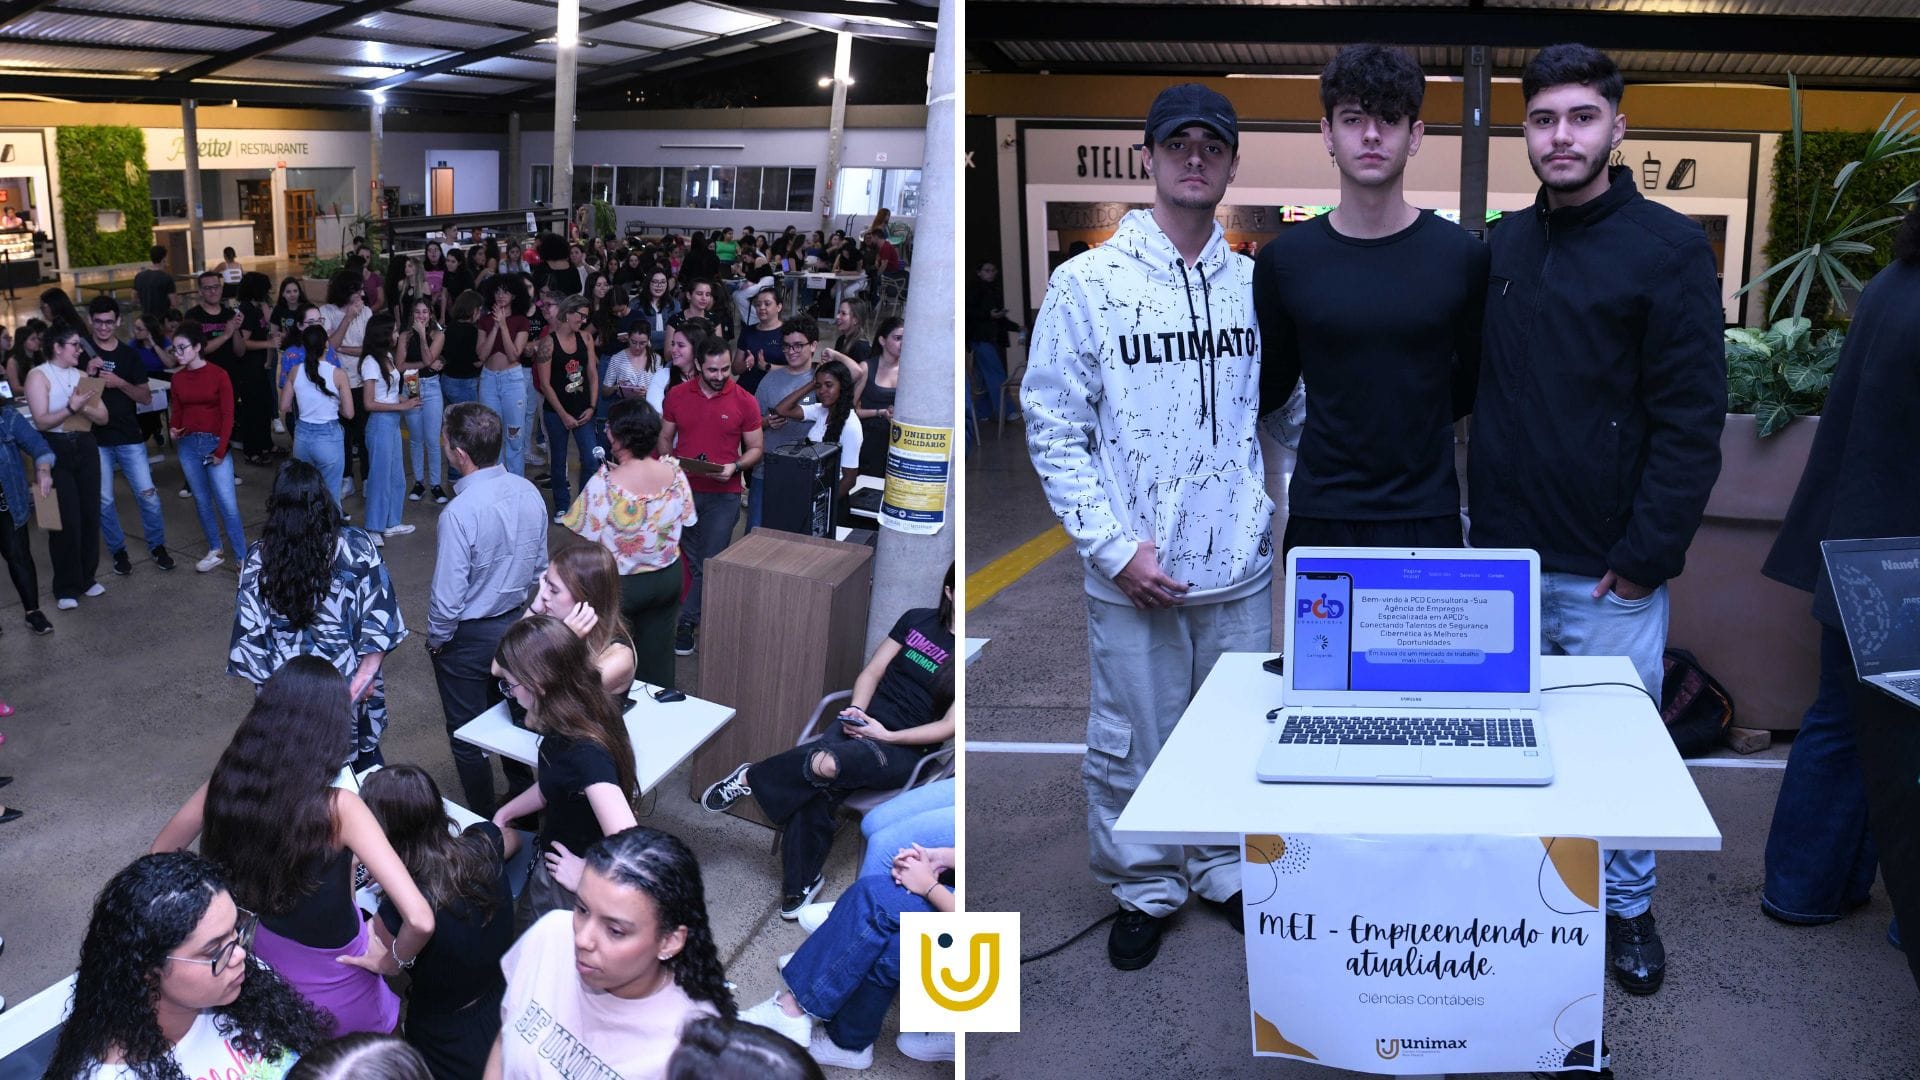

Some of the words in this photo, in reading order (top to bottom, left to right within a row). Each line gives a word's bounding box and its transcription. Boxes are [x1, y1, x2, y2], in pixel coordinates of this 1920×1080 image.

[240, 143, 309, 155] RESTAURANTE
[1119, 327, 1256, 366] ULTIMATO
[904, 430, 946, 440] UNIEDUK
[1426, 596, 1468, 604] Consultoria
[1297, 597, 1345, 619] PCD
[1385, 605, 1414, 613] Agência
[1426, 605, 1464, 613] Empregos
[1378, 613, 1428, 621] Especializada
[1449, 622, 1489, 631] Segurança
[1434, 630, 1468, 638] Melhores
[1397, 638, 1451, 647] Oportunidades
[905, 649, 939, 674] UNIMAX
[1259, 911, 1318, 941] MEI
[1347, 914, 1545, 950] Empreendendo
[1551, 924, 1590, 947] na
[1346, 947, 1496, 981] atualidade.
[1358, 992, 1415, 1006] Ciências
[1417, 993, 1485, 1007] Contábeis
[1400, 1037, 1468, 1049] unimax
